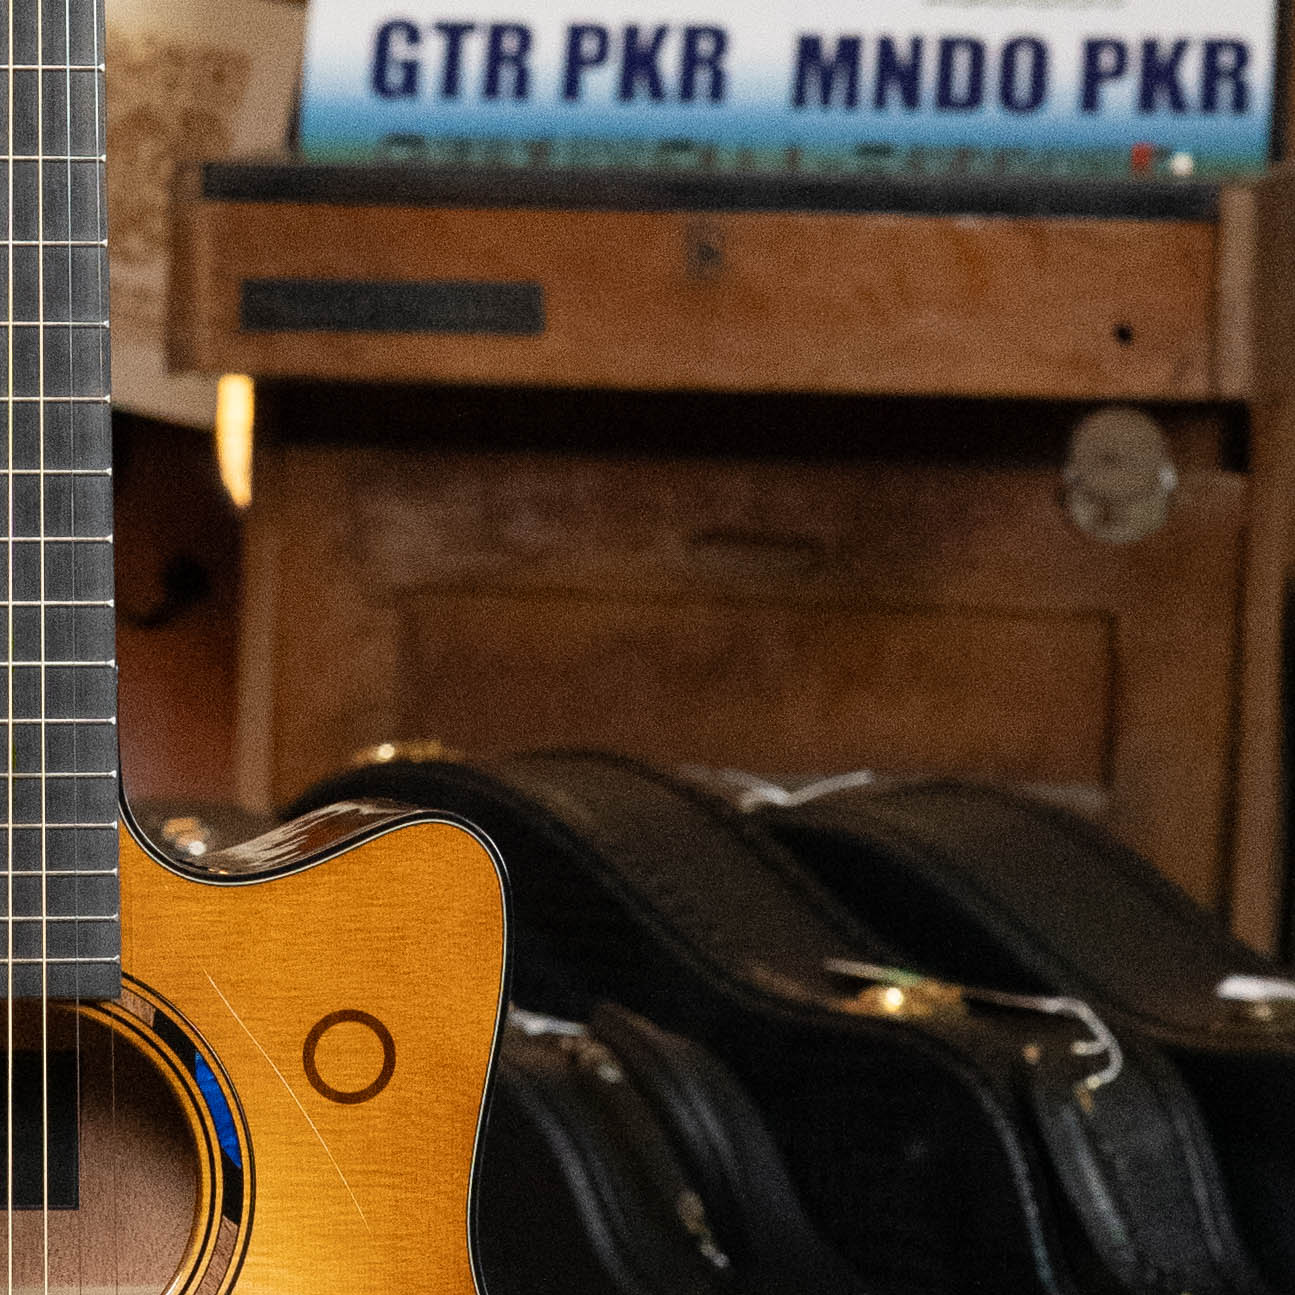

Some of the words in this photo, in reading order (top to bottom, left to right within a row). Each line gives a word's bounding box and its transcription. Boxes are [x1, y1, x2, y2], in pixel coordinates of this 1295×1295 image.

[369, 18, 534, 103] GTR
[561, 21, 730, 104] PKR
[790, 33, 1050, 115] MNDO
[1079, 37, 1253, 117] PKR
